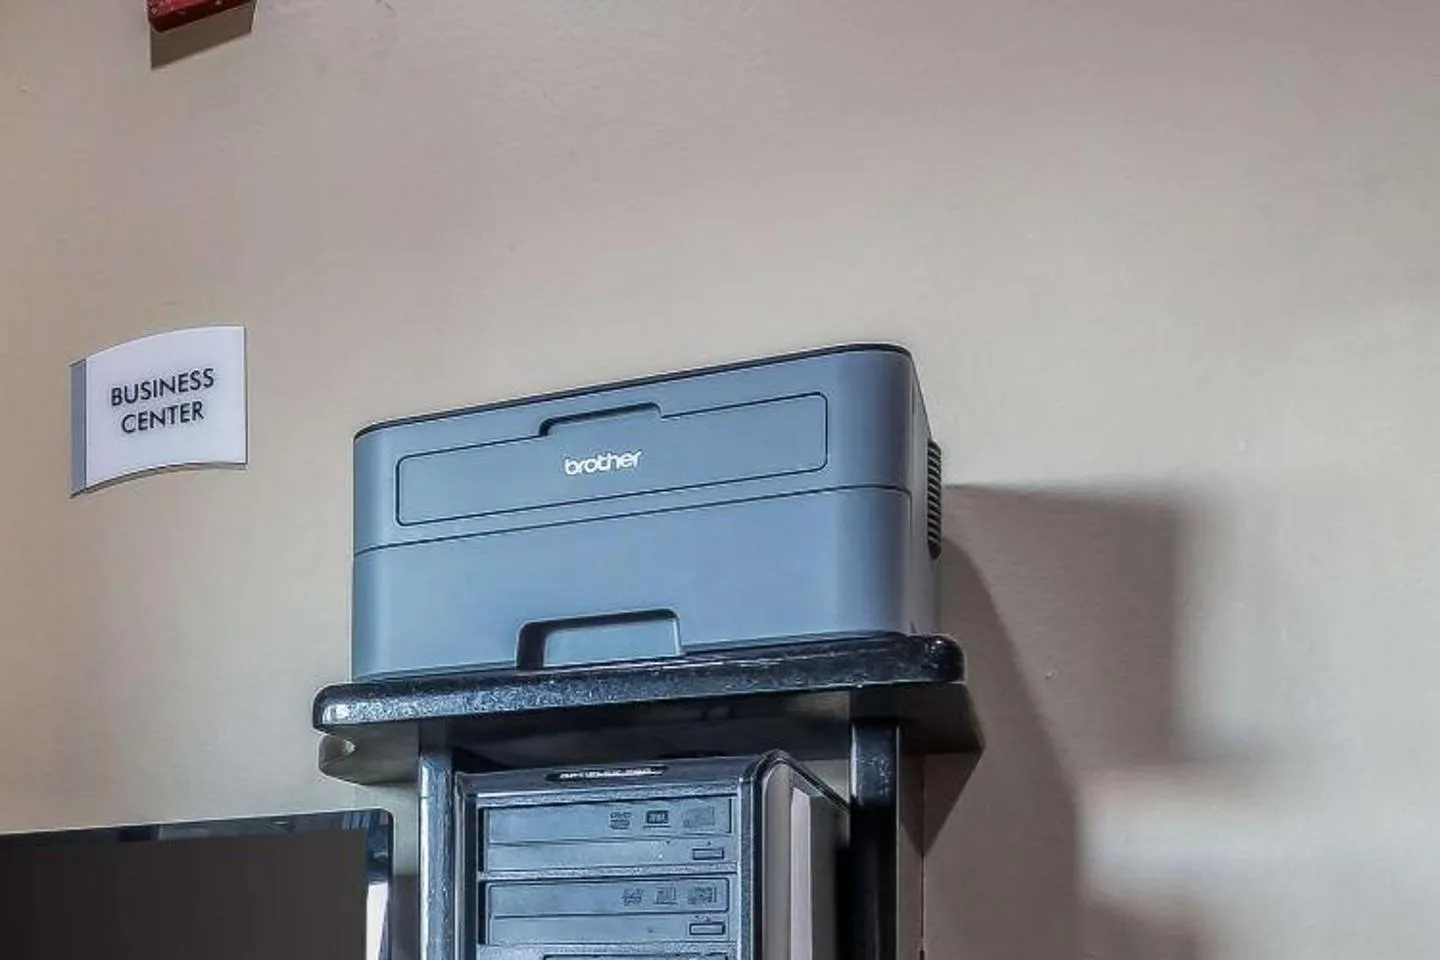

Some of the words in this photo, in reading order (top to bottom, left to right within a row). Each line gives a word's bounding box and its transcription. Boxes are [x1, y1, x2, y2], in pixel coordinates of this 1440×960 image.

[111, 368, 214, 406] BUSINESS
[121, 401, 204, 434] CENTER
[564, 451, 642, 475] brother
